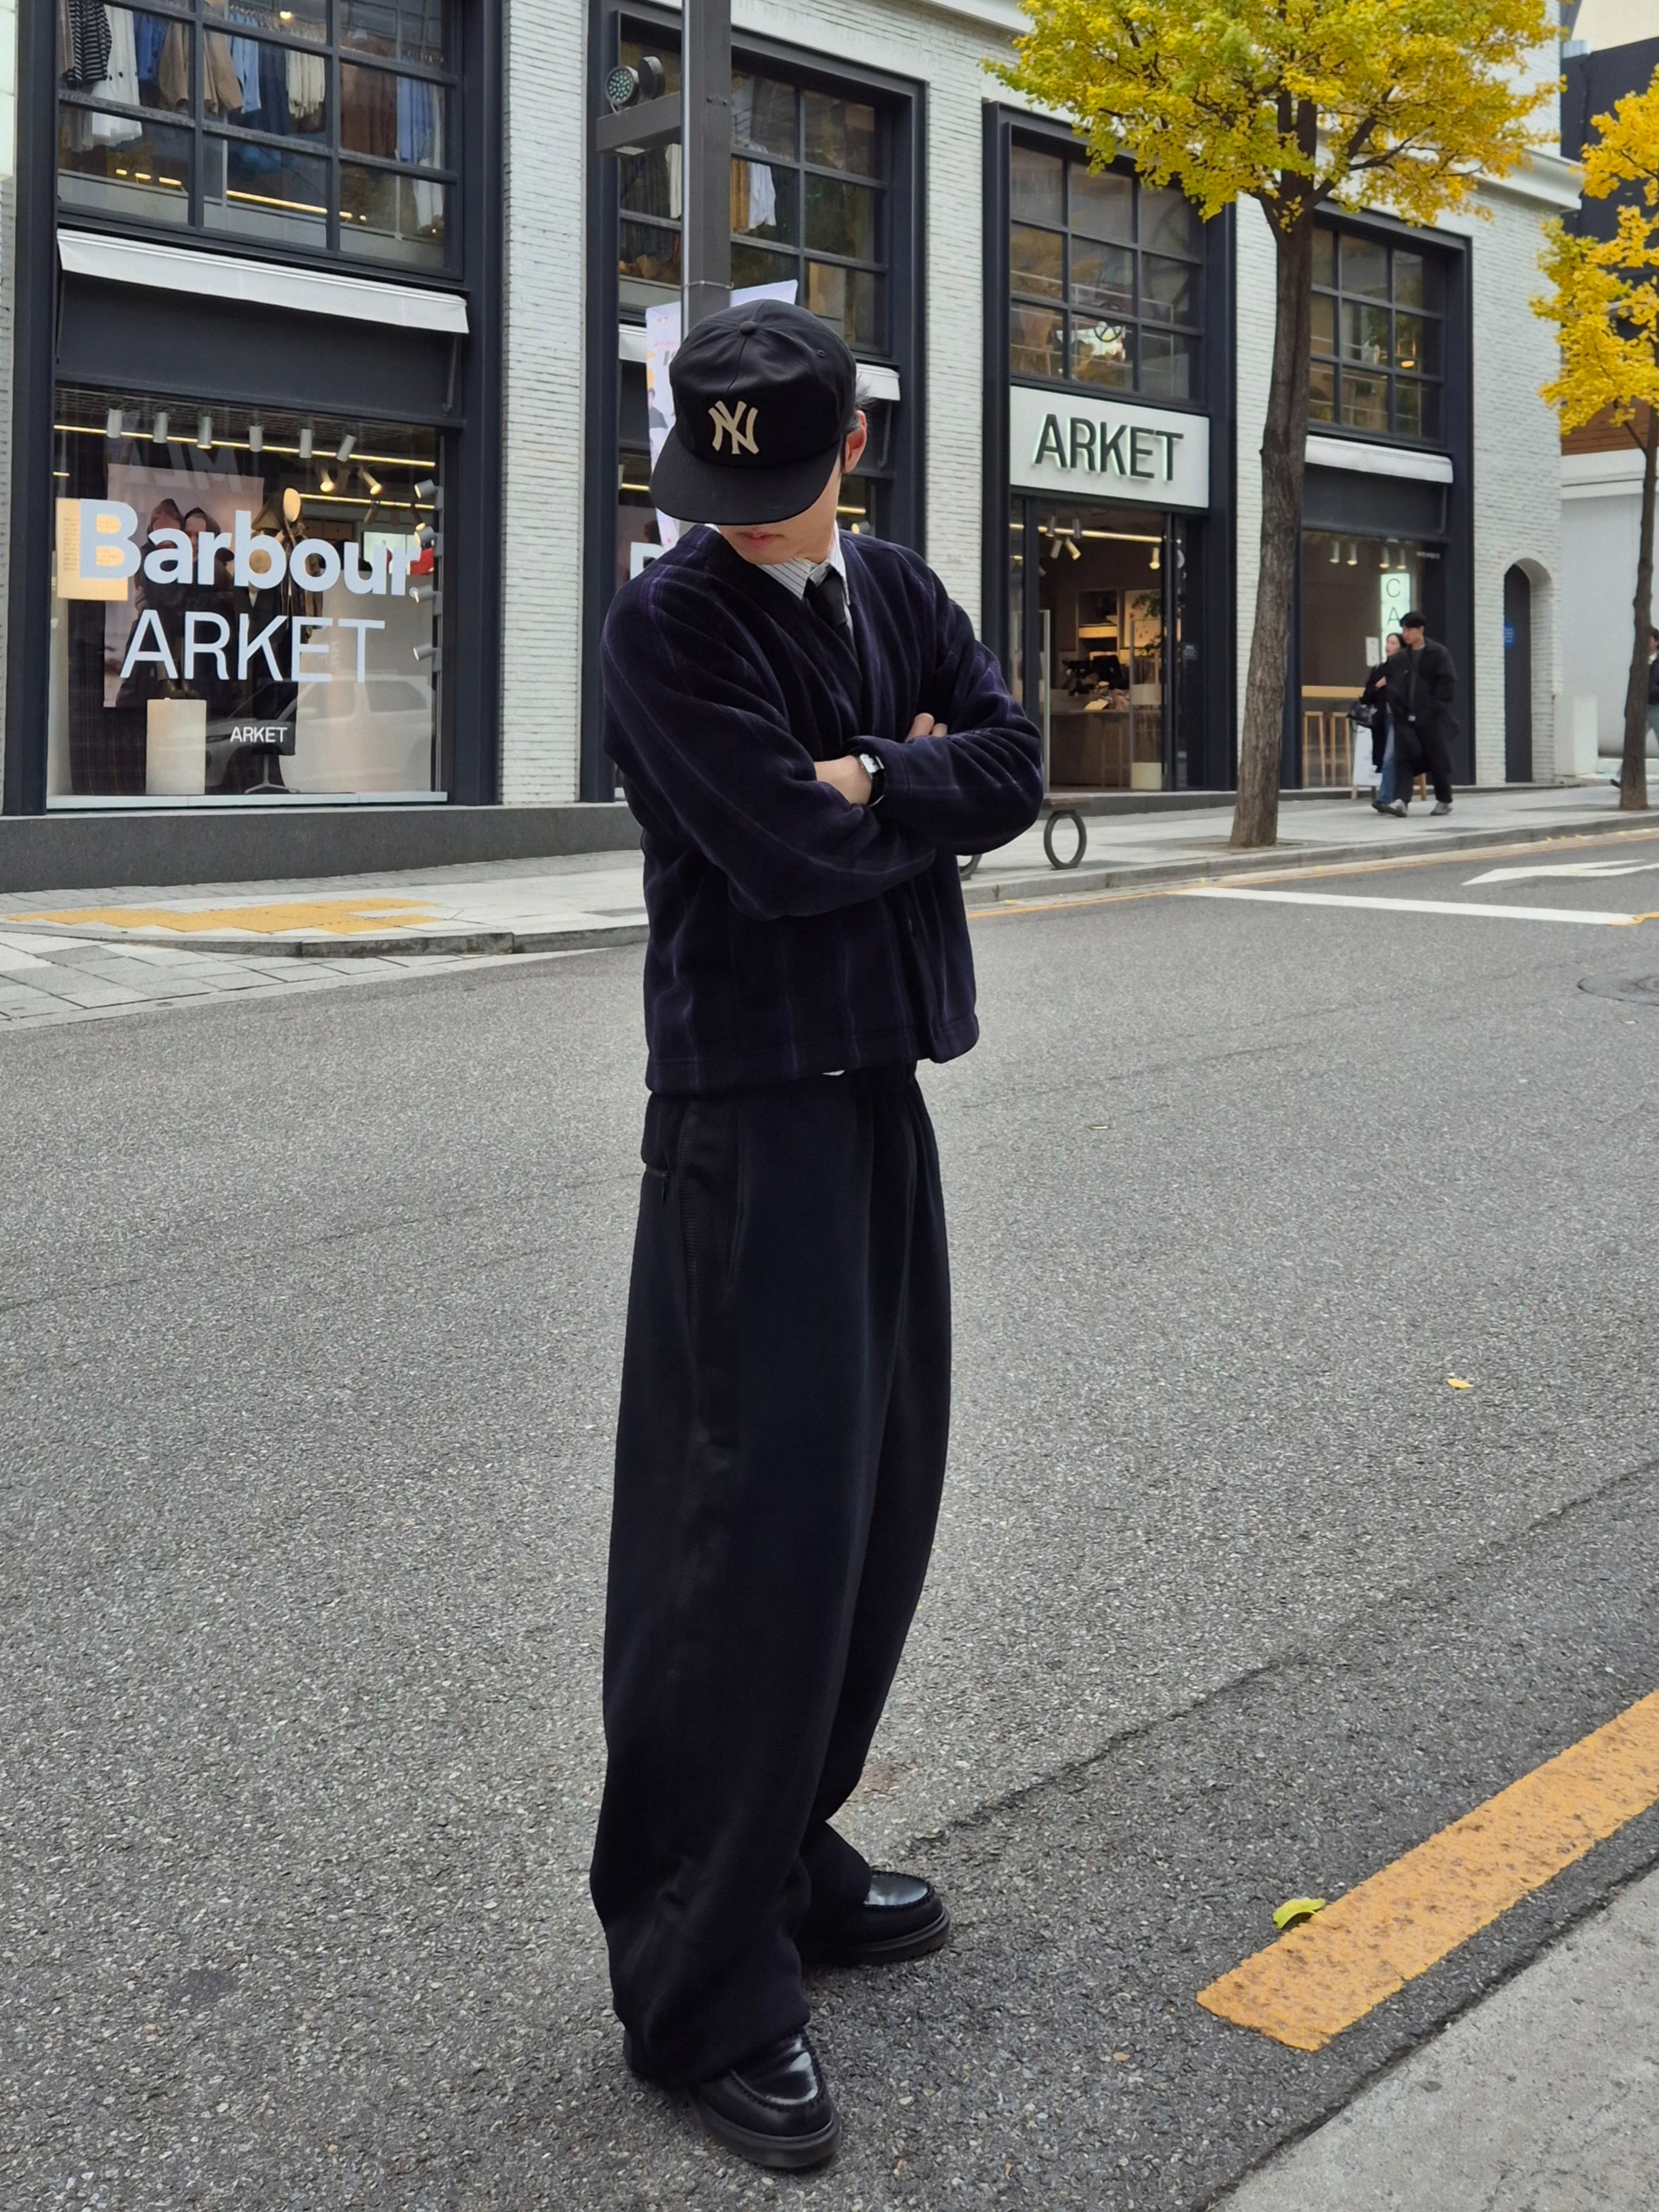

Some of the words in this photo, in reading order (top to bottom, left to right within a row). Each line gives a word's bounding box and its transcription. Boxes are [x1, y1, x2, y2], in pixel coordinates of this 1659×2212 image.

[708, 400, 760, 454] NY
[1034, 413, 1185, 481] ARKET
[79, 498, 421, 596] Barbour
[1386, 577, 1401, 626] CA
[120, 609, 385, 683] ARKET
[230, 726, 288, 743] ARKET
